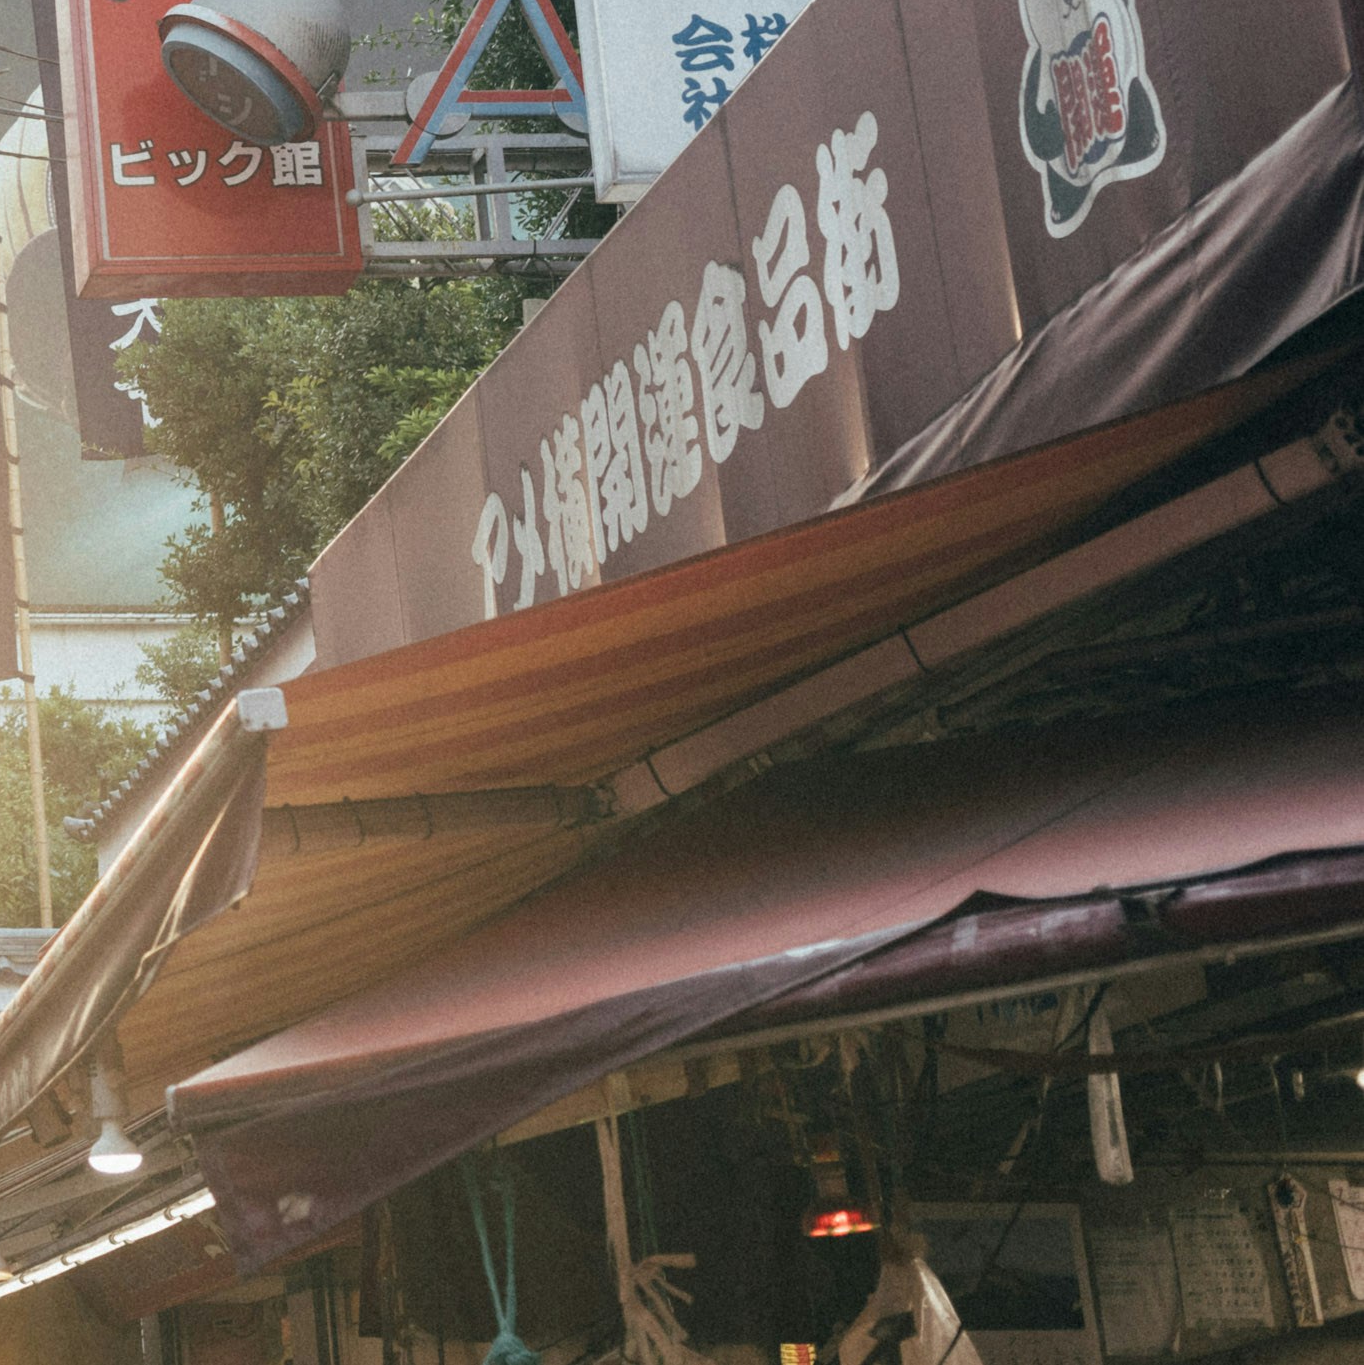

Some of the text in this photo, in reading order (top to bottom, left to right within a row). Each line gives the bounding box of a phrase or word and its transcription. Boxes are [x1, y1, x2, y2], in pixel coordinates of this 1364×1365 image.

[110, 139, 324, 188] ビック館
[1051, 15, 1127, 175] 開運
[472, 112, 901, 620] アメ横開運食品街
